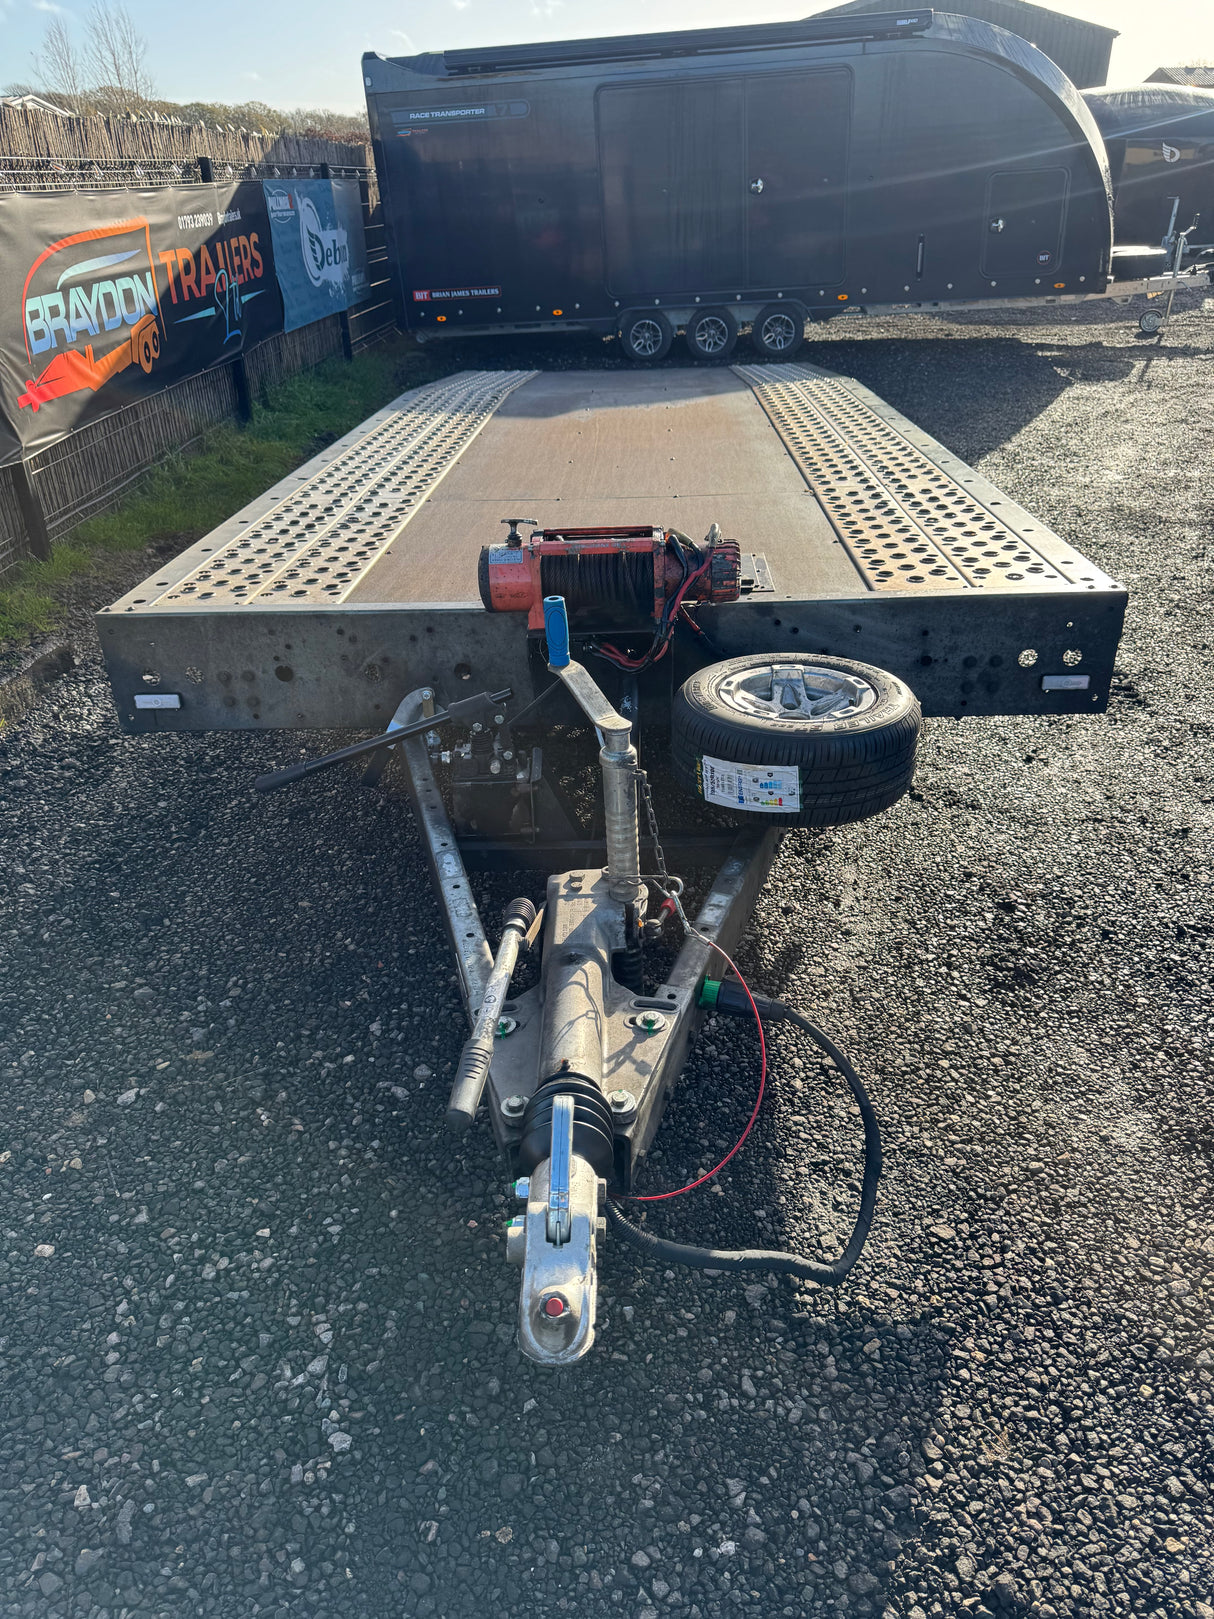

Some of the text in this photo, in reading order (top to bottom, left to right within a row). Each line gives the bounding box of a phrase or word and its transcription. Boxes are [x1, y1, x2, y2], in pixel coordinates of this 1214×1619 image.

[409, 112, 430, 120] RACE
[431, 108, 485, 118] TRANSPORTER
[177, 214, 194, 230] 01793
[306, 226, 348, 272] Debn
[158, 232, 263, 304] TRAILERS
[431, 290, 450, 299] BRIAN
[450, 288, 470, 298] JAMES
[470, 287, 500, 297] TRAILERS
[25, 271, 158, 355] BRAYDON
